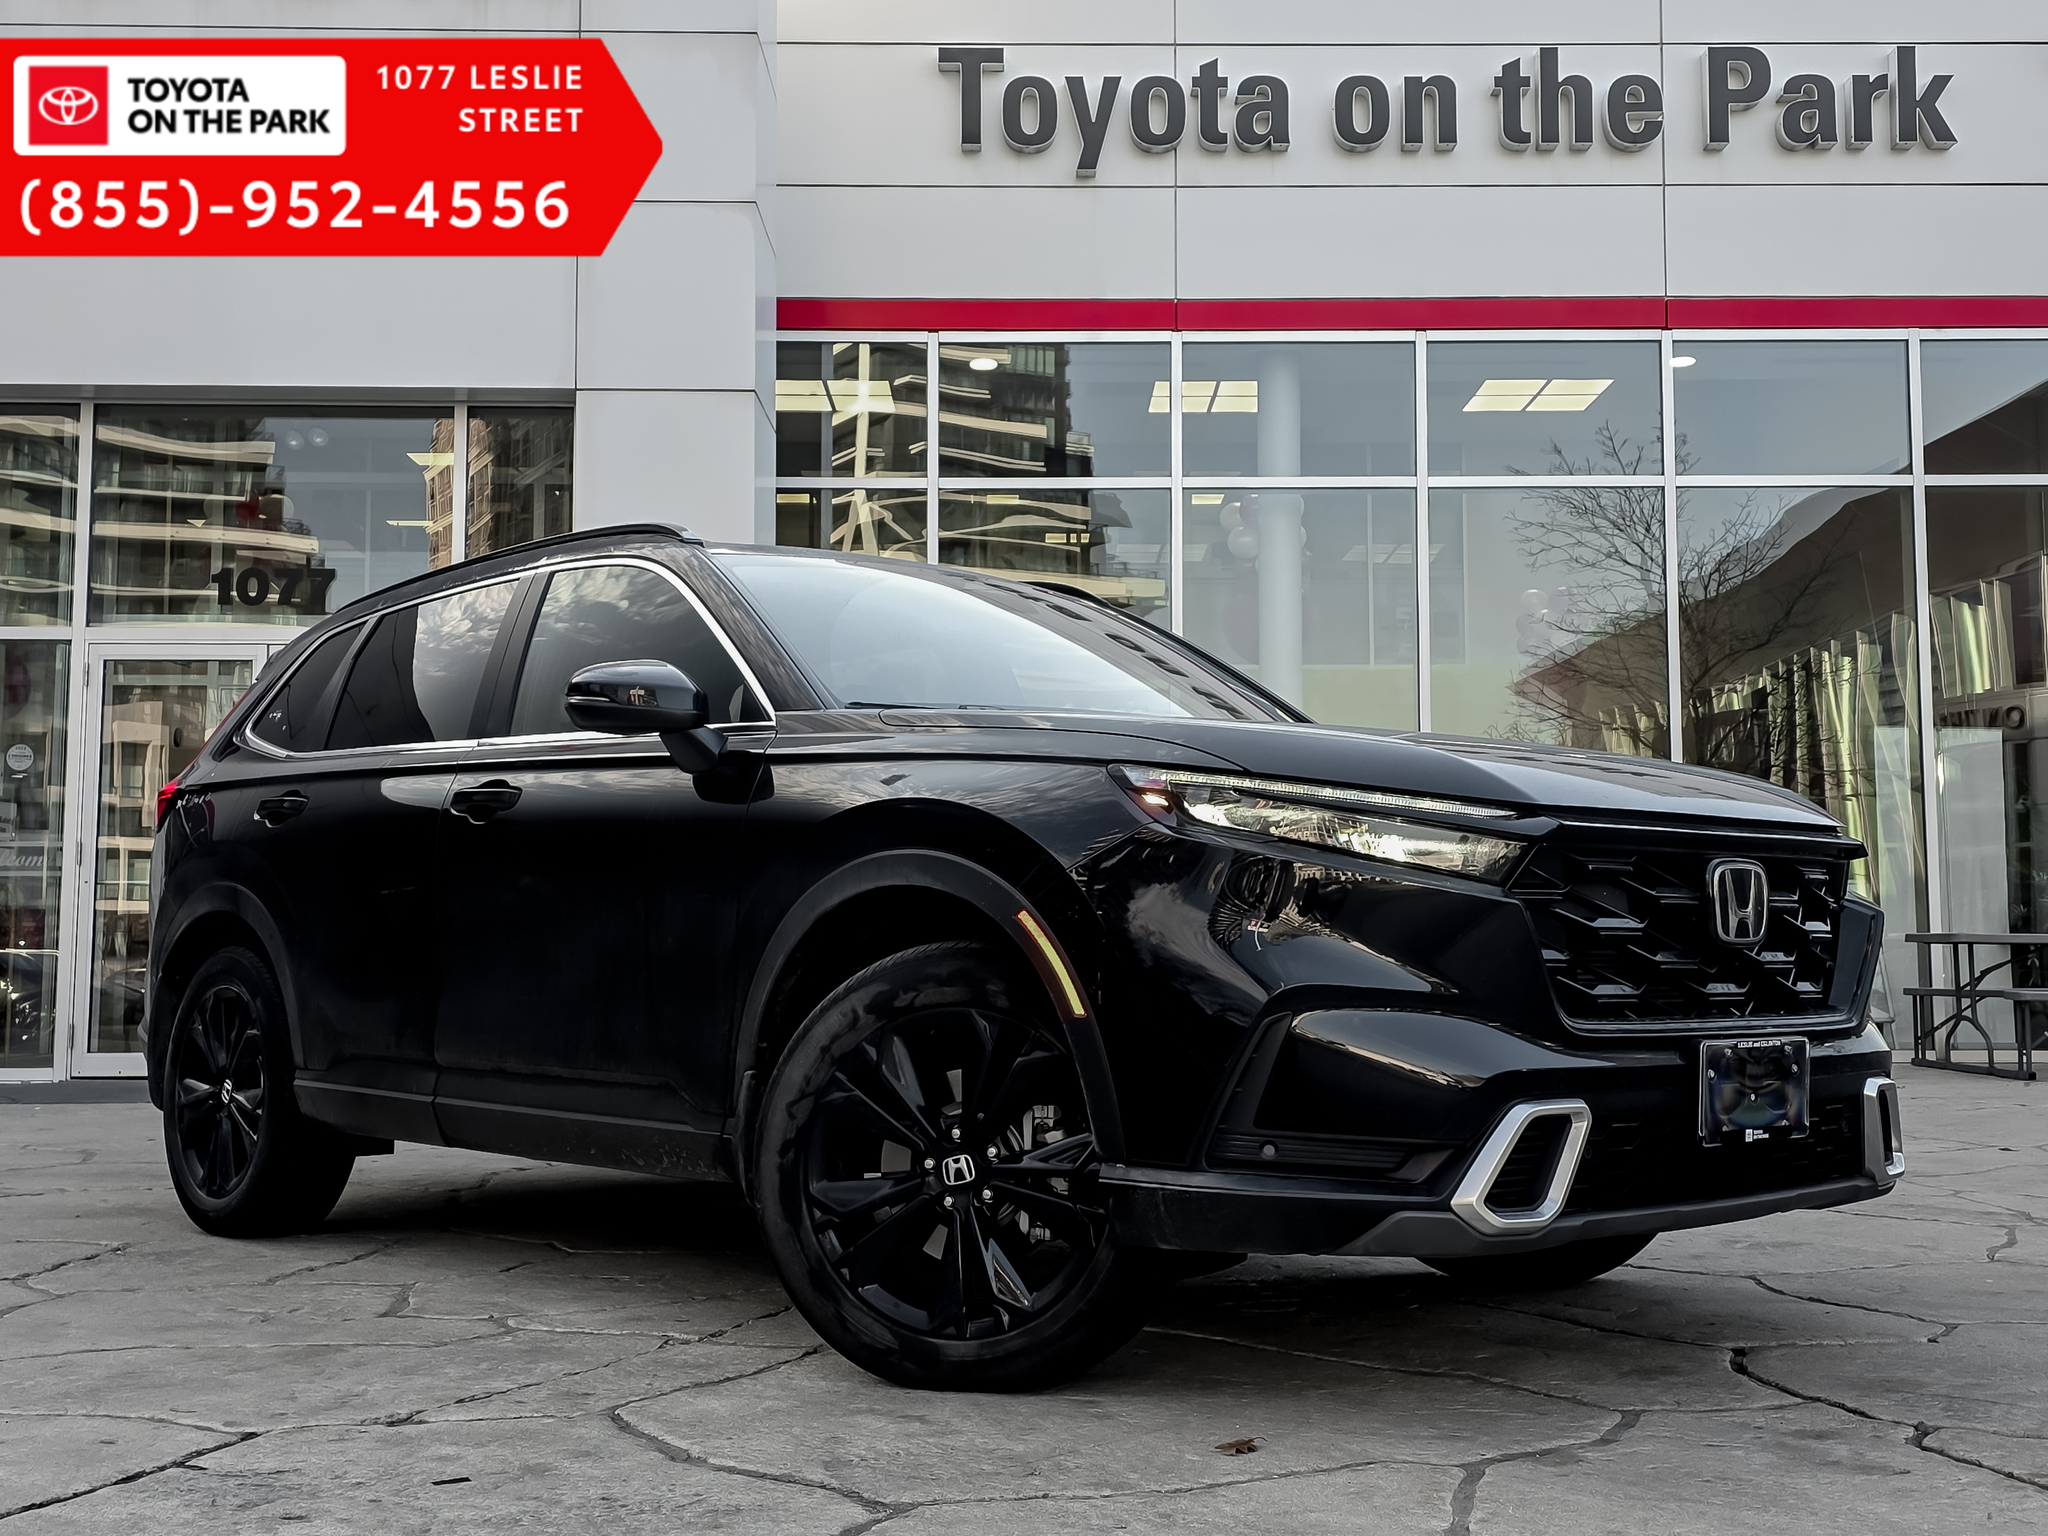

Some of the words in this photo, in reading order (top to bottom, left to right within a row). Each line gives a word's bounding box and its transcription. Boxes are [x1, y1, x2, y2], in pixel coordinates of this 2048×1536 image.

[938, 46, 1291, 178] Toyota
[1331, 74, 1458, 152] on
[1490, 46, 1664, 151] the
[1700, 45, 1958, 150] Park
[211, 567, 336, 607] 1077
